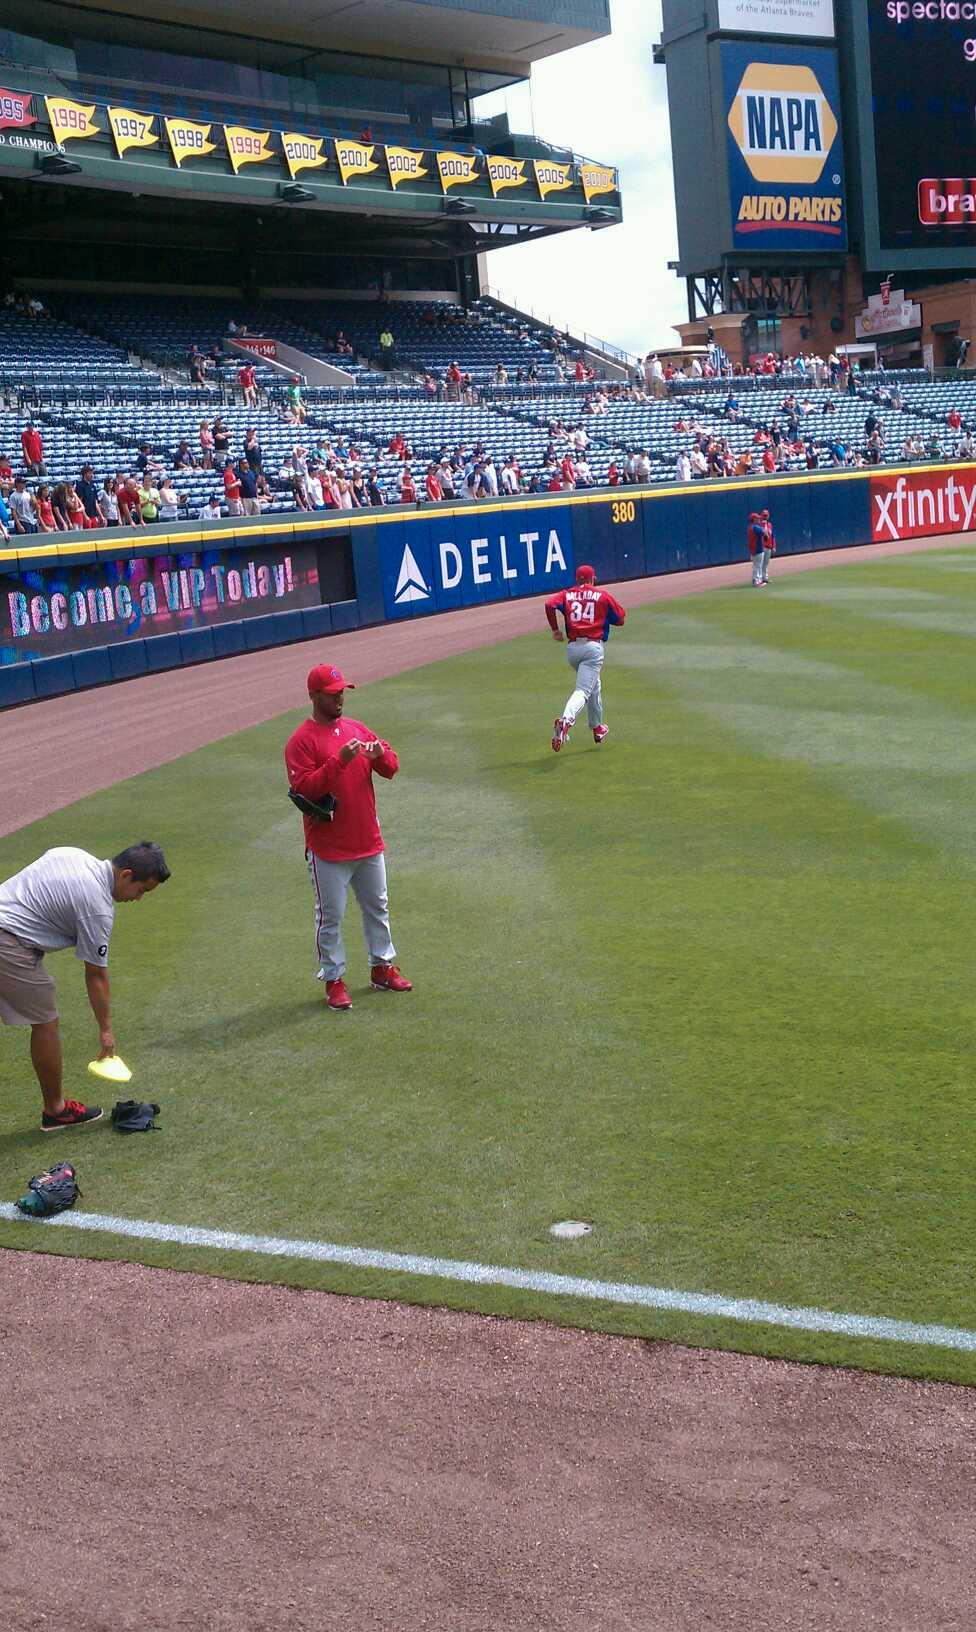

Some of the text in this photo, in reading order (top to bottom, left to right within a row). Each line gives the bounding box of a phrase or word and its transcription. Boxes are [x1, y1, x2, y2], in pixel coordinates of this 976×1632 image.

[52, 107, 88, 131] 1996
[114, 117, 146, 140] 1997
[746, 95, 822, 151] NAPA
[171, 128, 204, 149] 1998
[229, 135, 262, 156] 1999
[285, 141, 317, 161] 2000
[339, 149, 368, 168] 2001
[389, 155, 417, 174] 2002
[441, 160, 470, 178] 2003
[490, 164, 518, 181] 2004
[537, 168, 564, 185] 2005
[738, 195, 842, 222] AUTO PARTS
[611, 500, 636, 524] 380
[875, 475, 976, 539] xfinity
[438, 528, 568, 590] DELTA
[7, 555, 295, 638] Become a VIP Today!
[570, 601, 596, 625] 34
